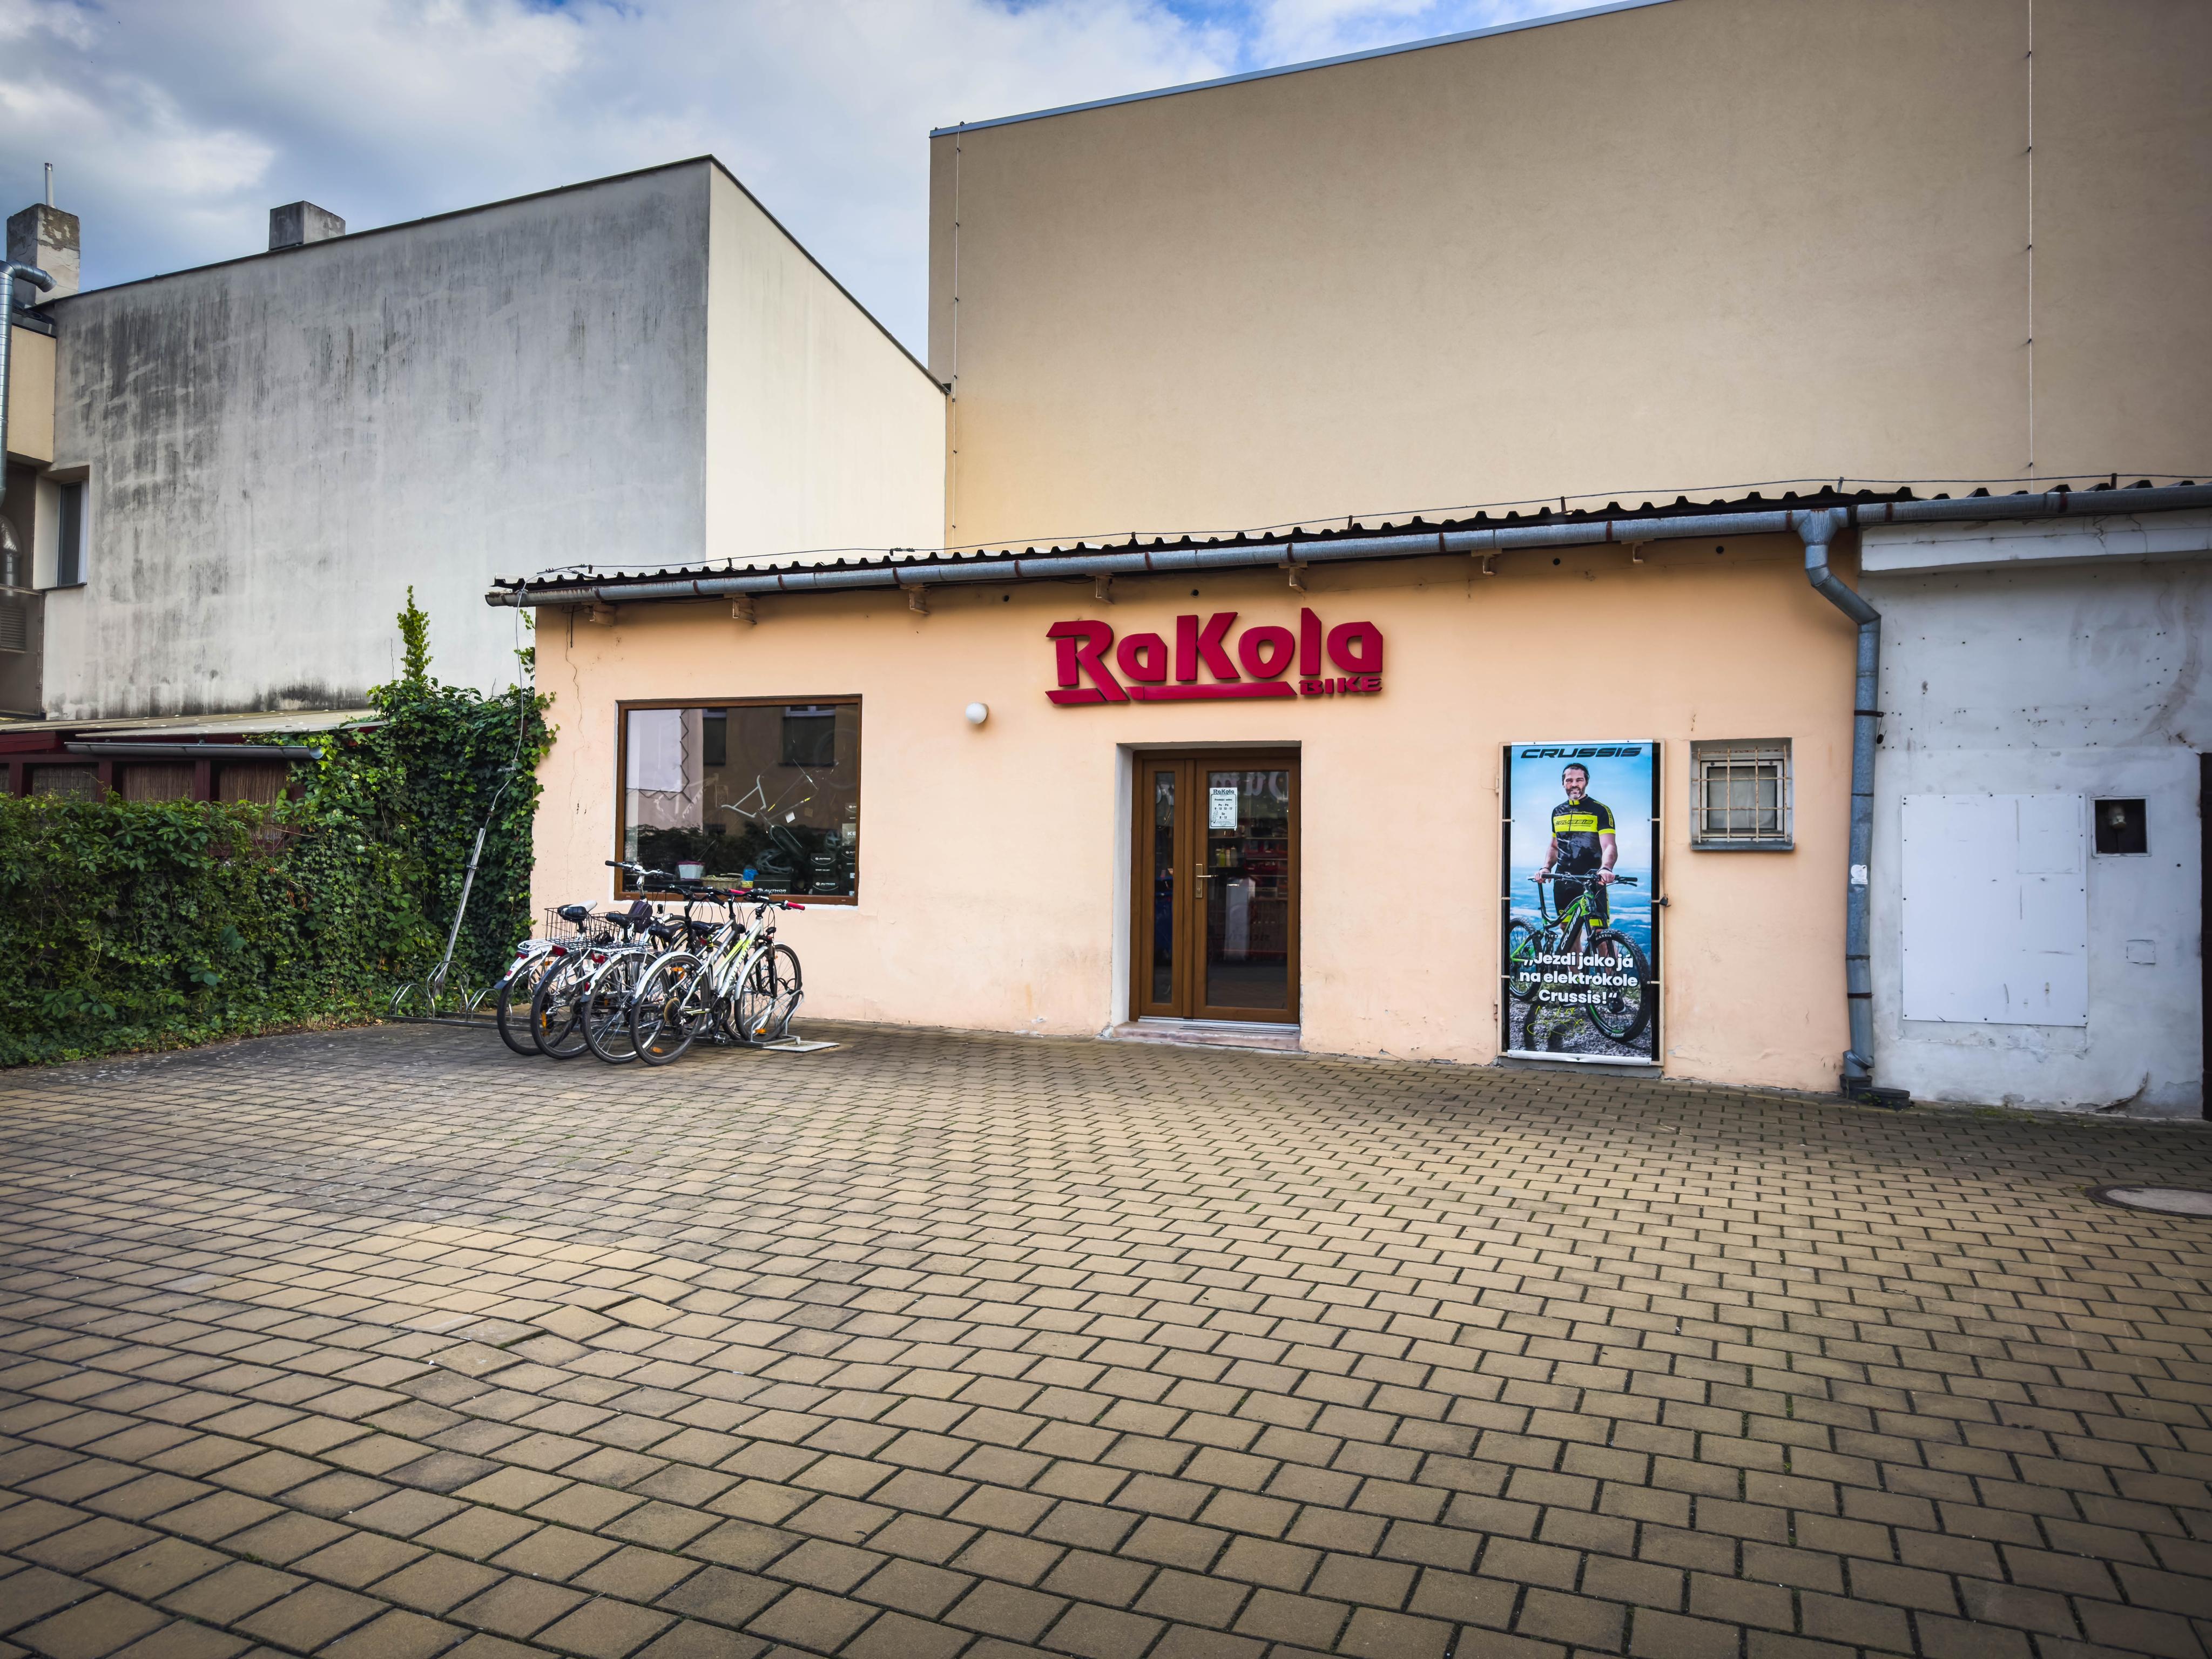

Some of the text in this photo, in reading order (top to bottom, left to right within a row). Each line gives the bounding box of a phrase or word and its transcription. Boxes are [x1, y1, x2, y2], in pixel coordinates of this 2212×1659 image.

[1046, 607, 1383, 701] RaKola
[1298, 676, 1382, 695] BIKE
[1521, 747, 1642, 759] CRUSSIS
[1561, 906, 1581, 950] CRUSSIS
[1577, 953, 1615, 970] jako
[1616, 954, 1634, 972] já
[1520, 971, 1638, 987] na elektrokole
